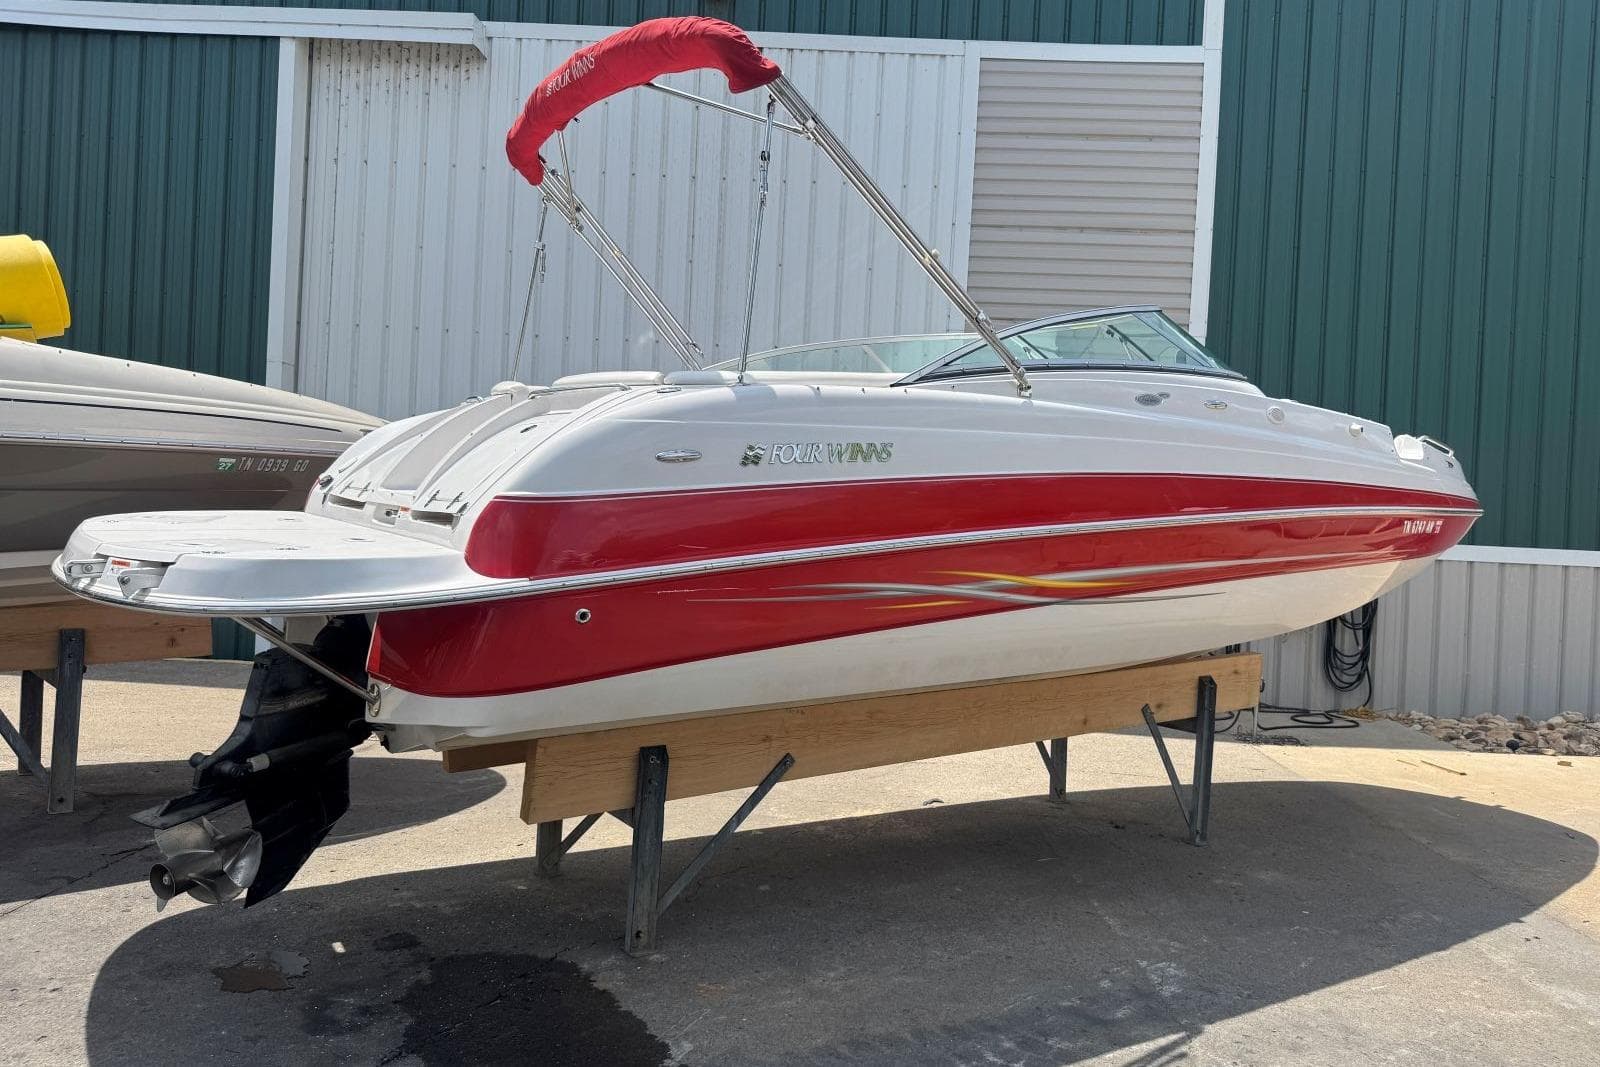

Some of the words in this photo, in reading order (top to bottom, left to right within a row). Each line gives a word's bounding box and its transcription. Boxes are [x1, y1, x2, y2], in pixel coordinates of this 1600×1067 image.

[552, 68, 571, 93] FOUR
[571, 52, 595, 80] WINNS
[768, 443, 823, 464] FOUR
[827, 442, 894, 463] WINNS
[218, 462, 233, 470] 27
[239, 456, 255, 471] TN
